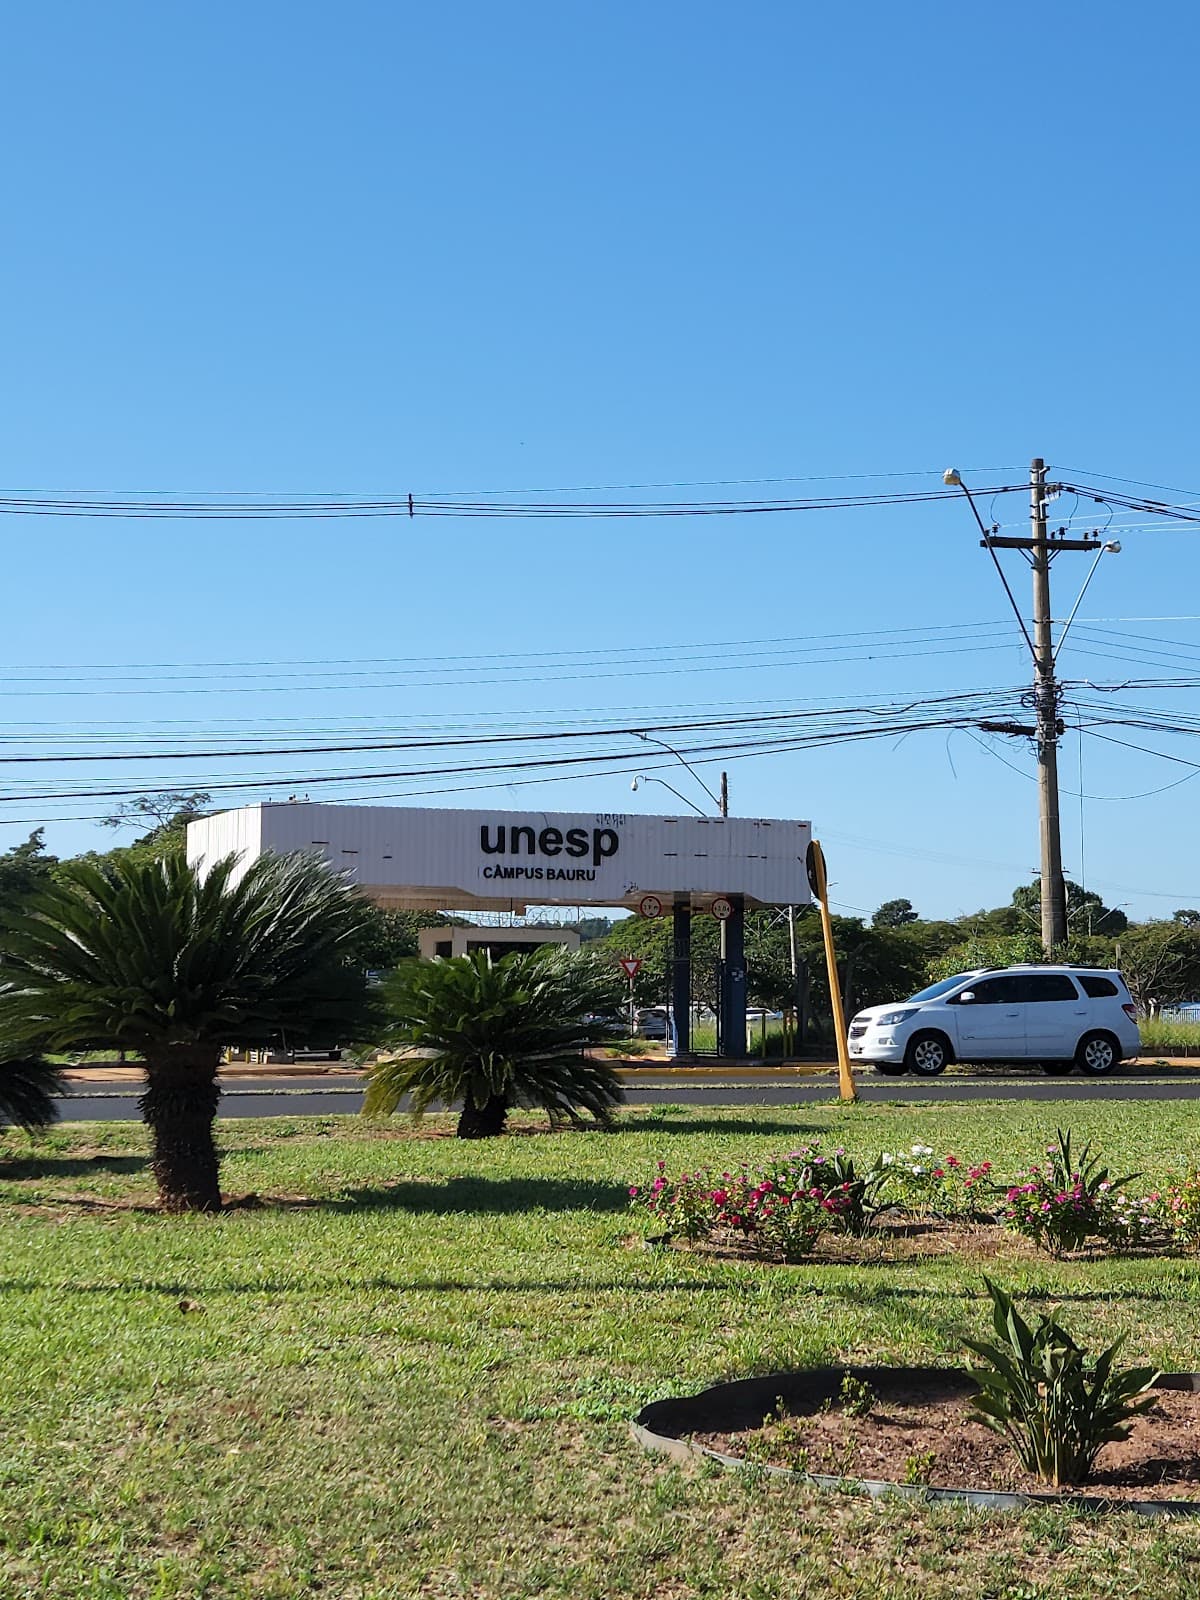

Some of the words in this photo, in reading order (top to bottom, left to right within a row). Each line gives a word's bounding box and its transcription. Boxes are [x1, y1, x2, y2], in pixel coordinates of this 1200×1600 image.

[480, 825, 619, 866] unesp
[483, 864, 544, 880] CÂMPUS
[546, 868, 596, 881] BAURU
